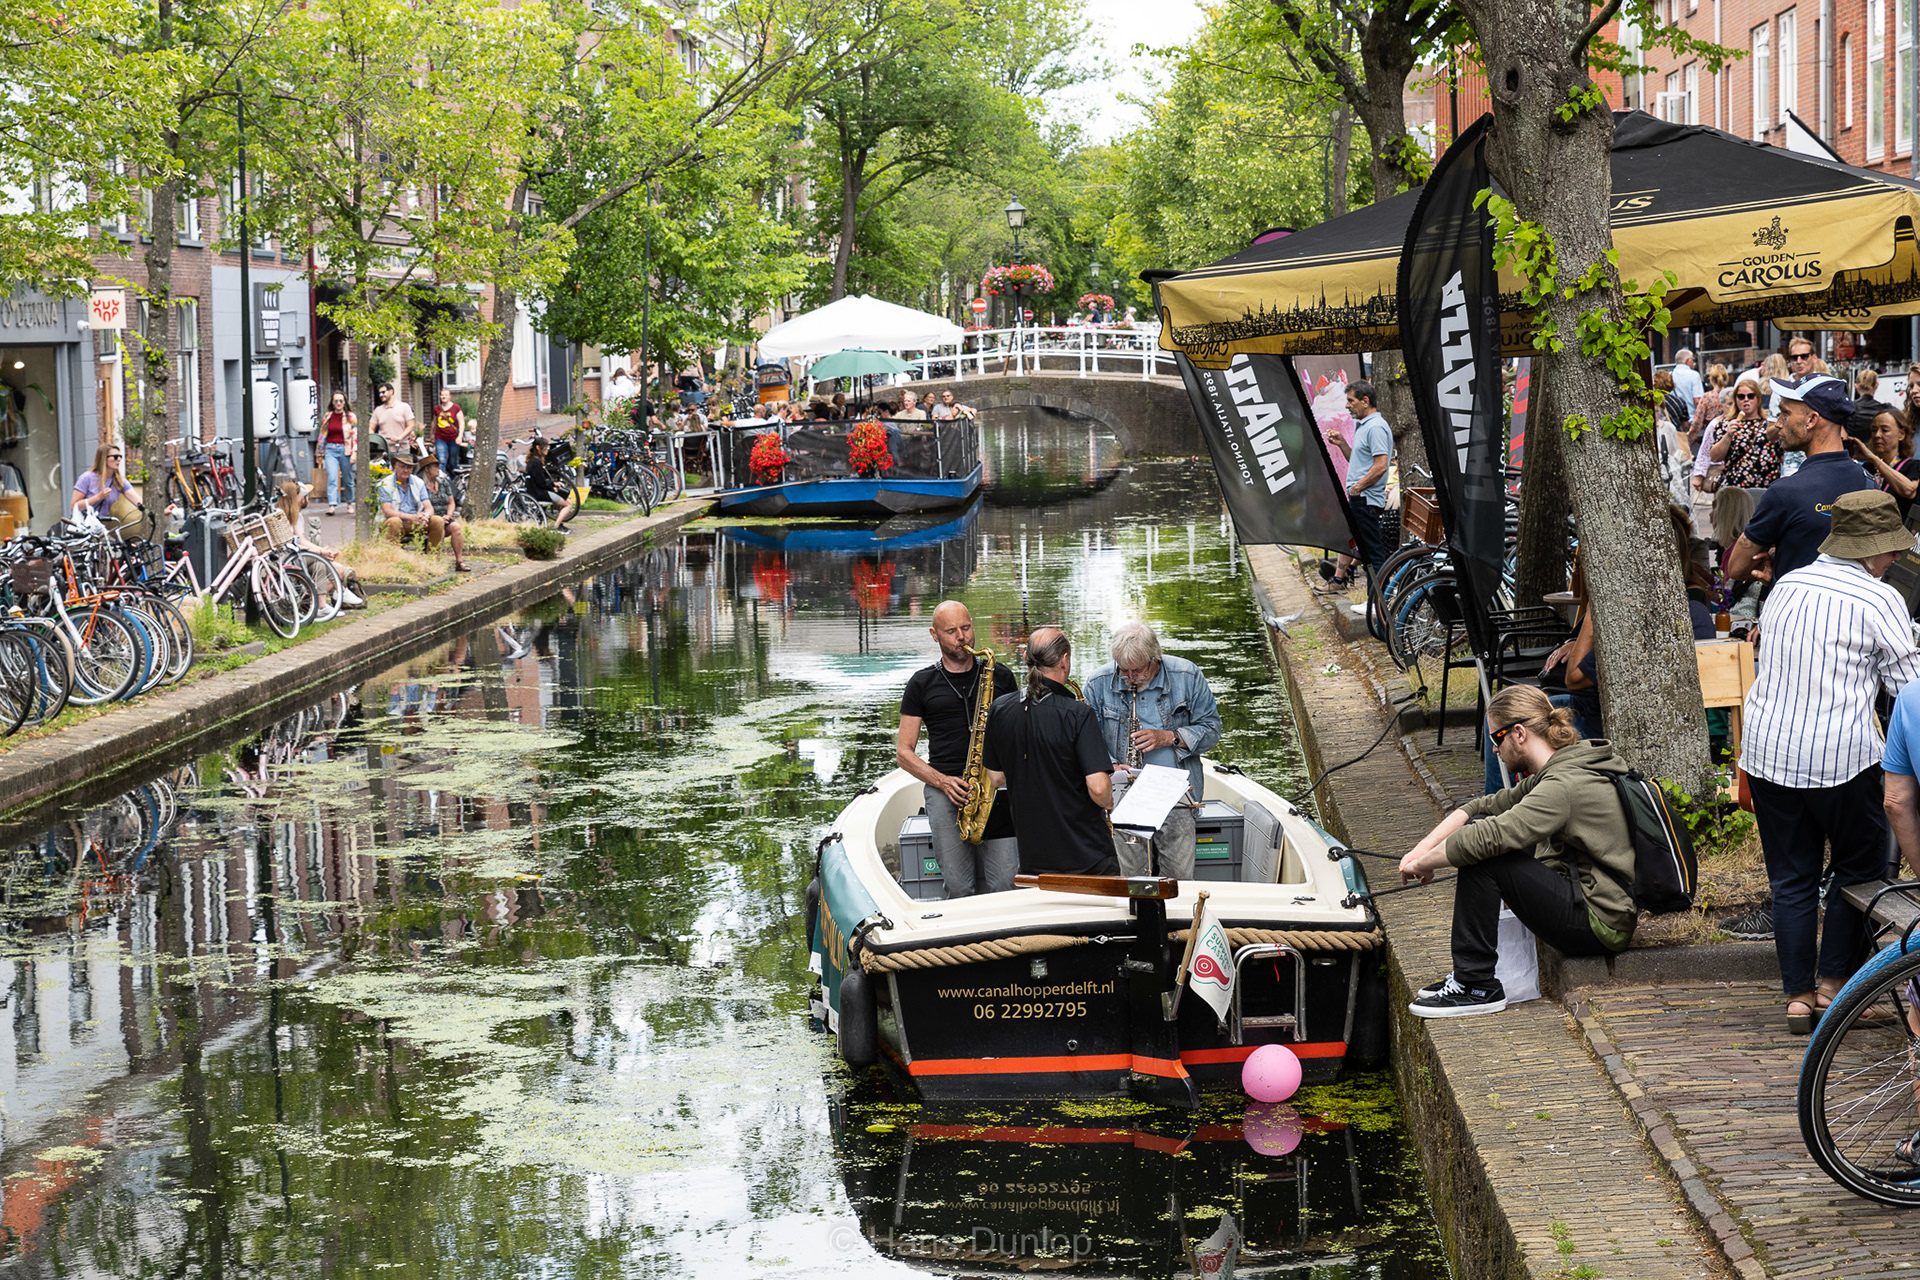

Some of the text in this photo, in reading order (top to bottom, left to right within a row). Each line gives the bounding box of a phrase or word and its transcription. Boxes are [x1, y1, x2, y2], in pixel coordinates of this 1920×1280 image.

[1742, 252, 1795, 267] GOUDEN
[1718, 260, 1822, 287] CAROLUS
[269, 386, 279, 433] ラーメン
[937, 980, 1115, 999] www.canalhopperdelft.nl
[973, 1002, 1088, 1019] 06 22992795
